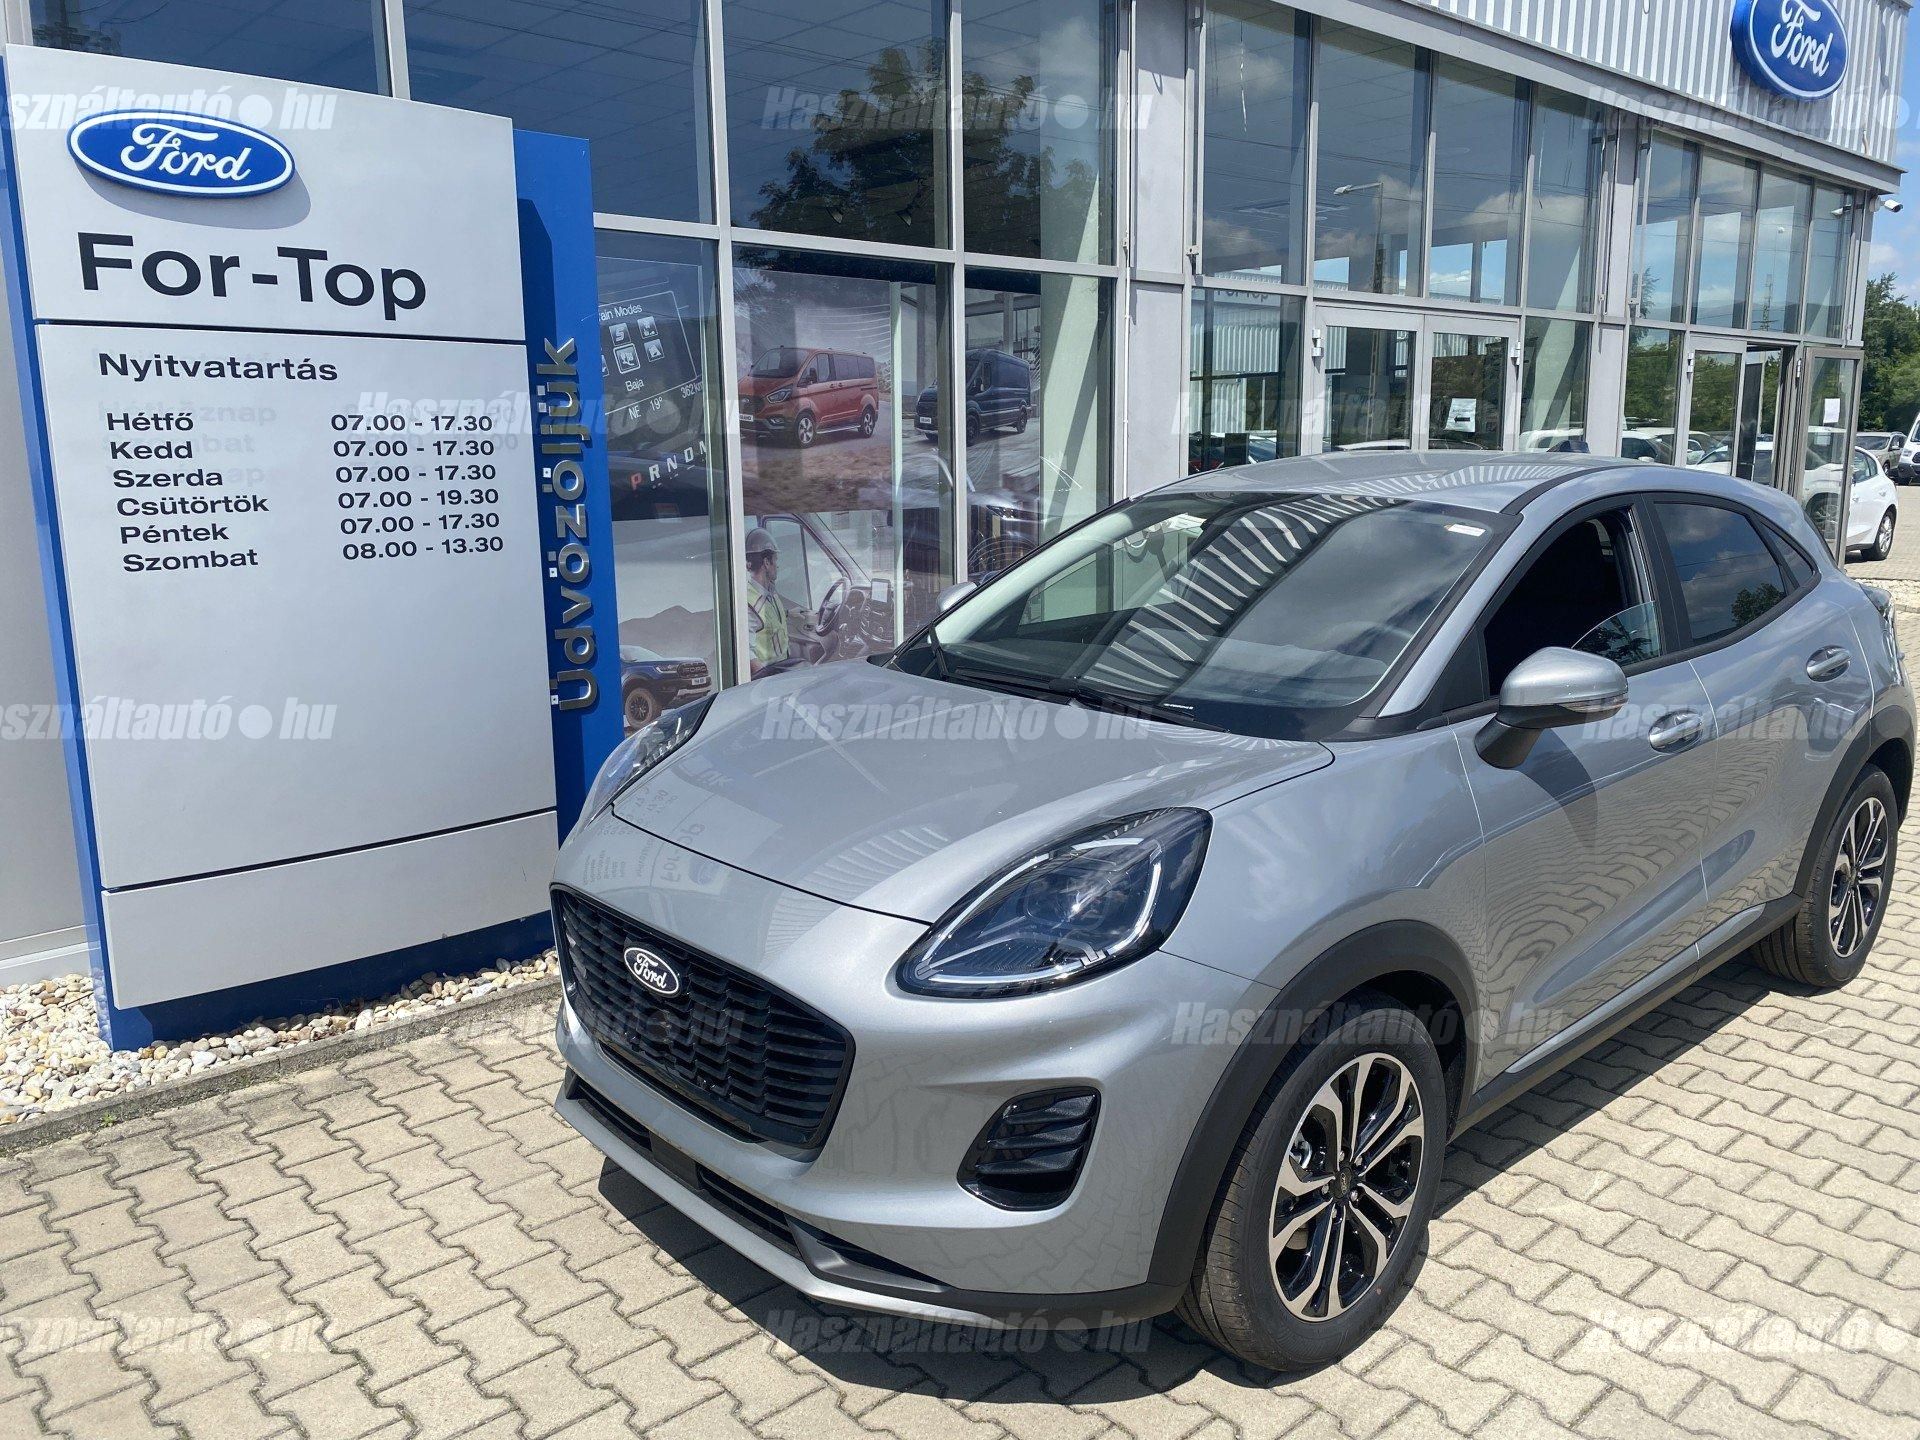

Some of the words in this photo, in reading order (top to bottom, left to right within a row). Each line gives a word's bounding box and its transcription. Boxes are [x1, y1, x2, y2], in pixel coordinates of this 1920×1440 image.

[1771, 0, 1834, 77] Ford
[120, 122, 251, 181] Ford
[77, 231, 427, 322] For-Top
[613, 303, 643, 318] Modes
[98, 352, 338, 382] Nyitvatartás
[625, 378, 645, 393] Baja
[106, 412, 194, 432] Hétfő
[330, 414, 406, 432] 07.00
[430, 415, 493, 432] 17.30
[628, 405, 642, 420] NE
[109, 440, 193, 460] Kedd
[333, 440, 408, 458] 07.00
[432, 439, 495, 456] 17.30
[112, 468, 223, 488] Szerda
[335, 465, 410, 484] 07.00
[434, 464, 497, 481] 17.30
[648, 464, 661, 482] R
[666, 454, 679, 474] N
[116, 494, 270, 517] Csütörtök
[337, 490, 412, 509] 07.00
[436, 488, 499, 506] 19.30
[120, 523, 230, 545] Péntek
[340, 515, 414, 535] 07.00
[438, 512, 500, 530] 17.30
[536, 337, 598, 711] Üdvözöljük
[342, 540, 418, 561] 08.00
[441, 536, 504, 555] 13.30
[122, 548, 259, 573] Szombat
[633, 952, 668, 989] Ford
